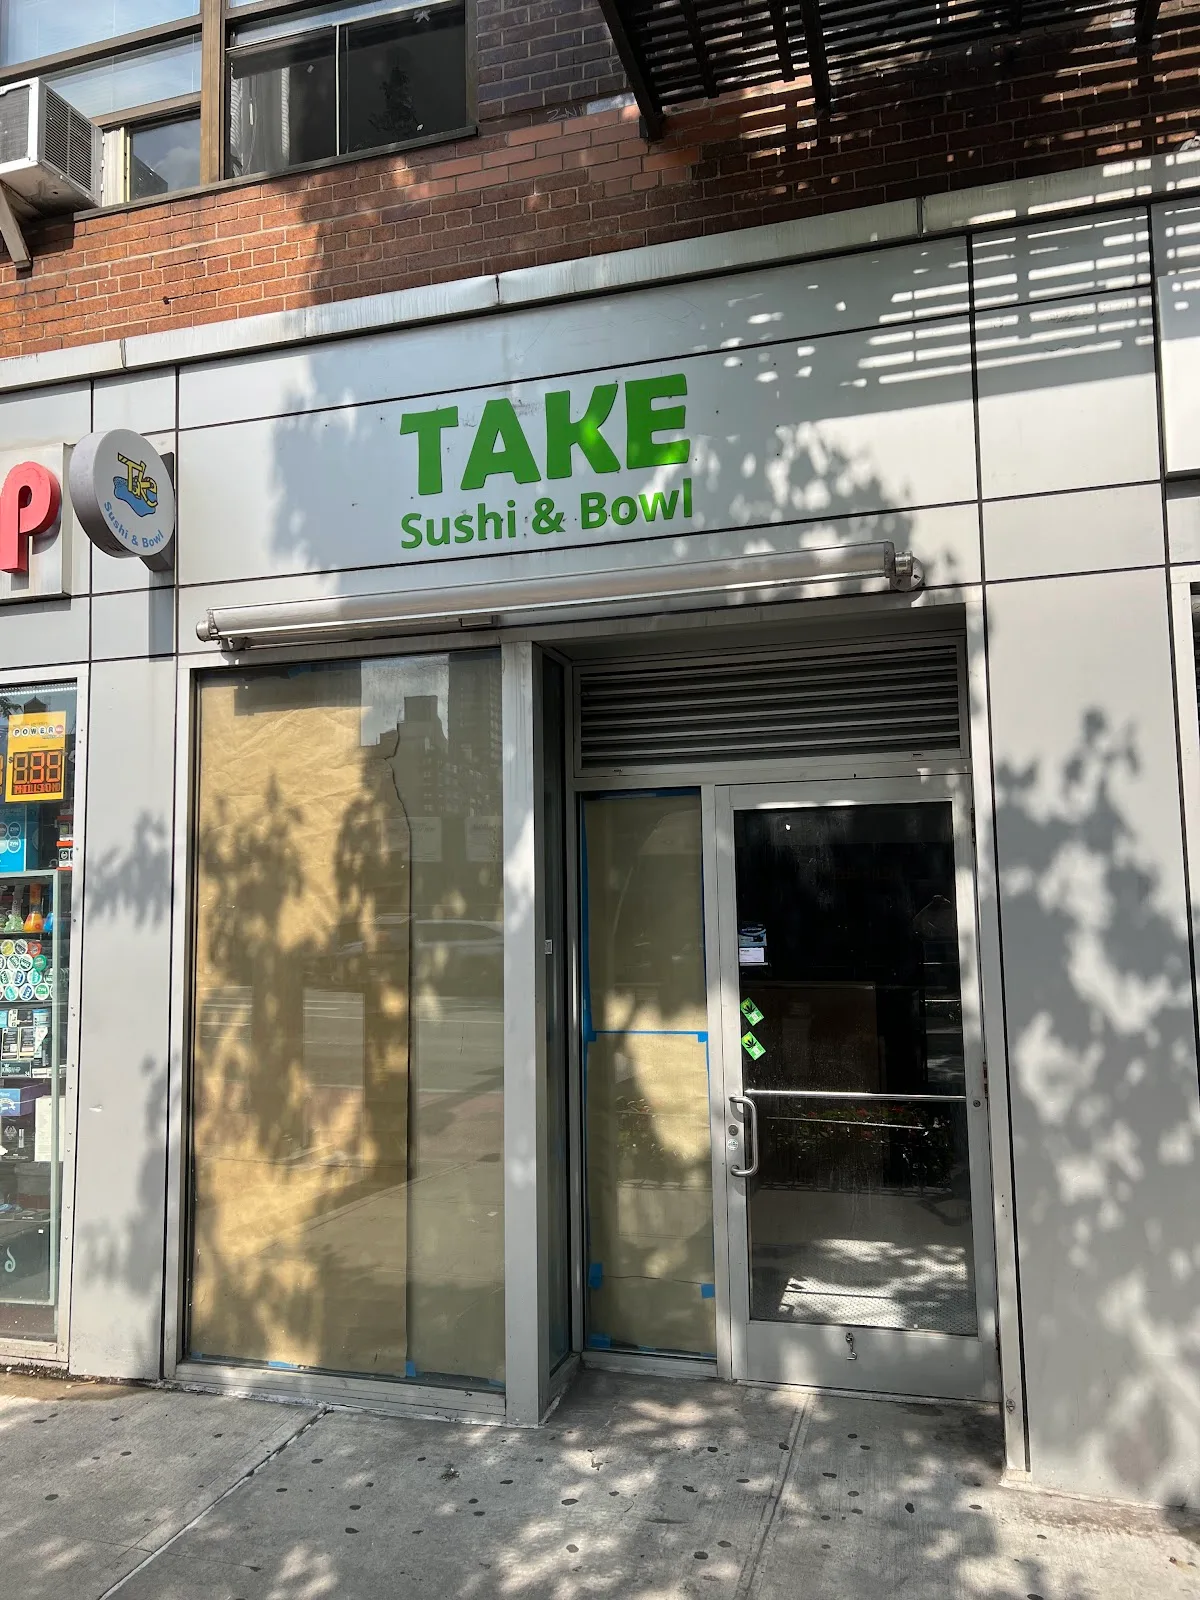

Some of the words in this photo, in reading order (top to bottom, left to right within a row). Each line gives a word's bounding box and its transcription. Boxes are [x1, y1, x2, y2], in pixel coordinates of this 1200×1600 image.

[400, 374, 691, 495] TAKE
[104, 501, 129, 539] Sushi
[131, 535, 138, 546] &
[141, 529, 164, 548] Bowl
[401, 500, 516, 549] Sushi
[531, 498, 566, 534] &
[580, 478, 692, 529] Bowl
